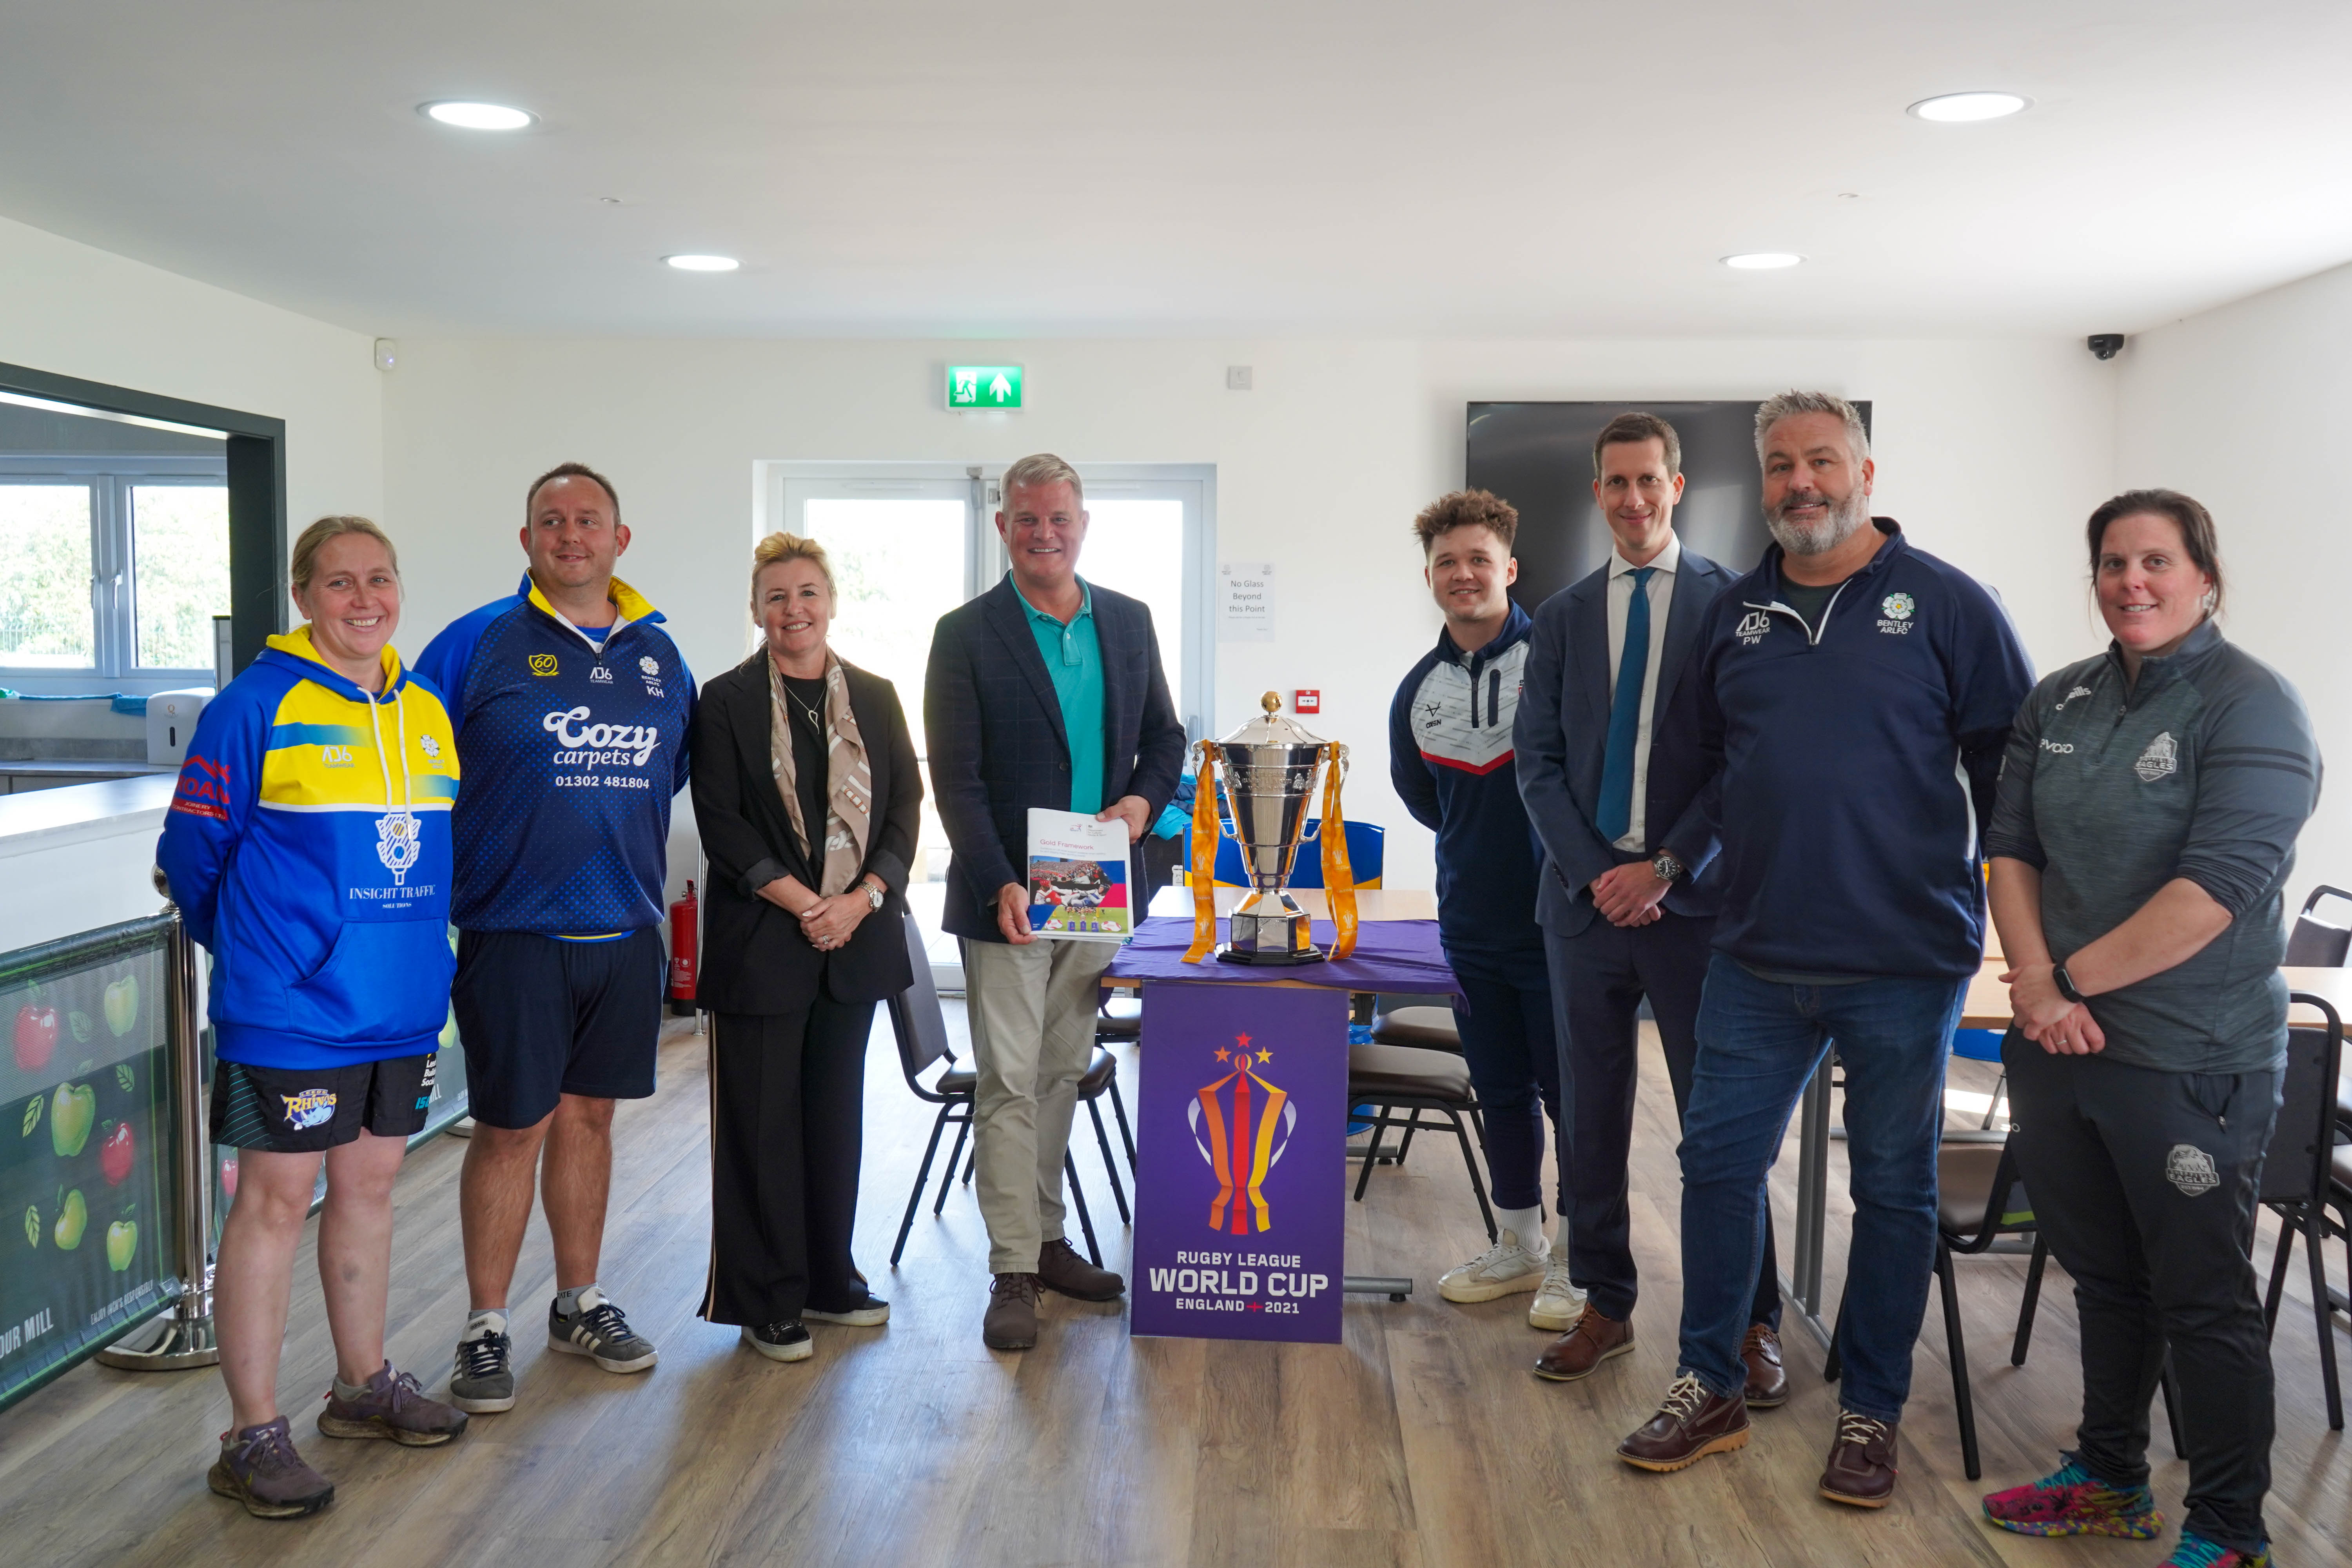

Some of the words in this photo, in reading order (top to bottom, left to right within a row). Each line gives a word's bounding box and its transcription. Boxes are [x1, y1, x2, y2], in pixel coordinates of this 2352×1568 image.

[1233, 593, 1261, 601] Beyond
[1736, 609, 1770, 632] AJ6
[1877, 619, 1914, 628] BENTLEY
[1735, 627, 1770, 637] TEAMWEAR
[1743, 635, 1762, 645] PW
[534, 657, 553, 668] 60
[589, 667, 613, 680] AJ6
[647, 686, 664, 698] KH
[1426, 719, 1441, 729] OXEN
[543, 706, 662, 766] Cozy
[322, 746, 352, 762] AJ6
[553, 749, 630, 771] carpets
[2135, 761, 2174, 770] EAGLES
[555, 776, 599, 786] 01302
[604, 776, 650, 789] 481804
[171, 804, 214, 816] CONTRACTORS
[185, 801, 211, 810] JOINERY
[1058, 841, 1094, 850] Framework
[349, 887, 398, 899] INSIGHT
[400, 884, 436, 898] TRAFFIC
[2170, 1173, 2216, 1183] EAGLES
[1177, 1251, 1232, 1265] RUGBY
[1238, 1254, 1301, 1268] LEAGUE
[1149, 1268, 1258, 1295] WORLD
[1268, 1272, 1328, 1298] CUP
[91, 1307, 106, 1325] ENJOY
[123, 1279, 153, 1307] RESPONSIBLY
[1176, 1298, 1245, 1312] ENGLAND
[1265, 1301, 1299, 1314] 2021
[24, 1307, 54, 1343] MILL
